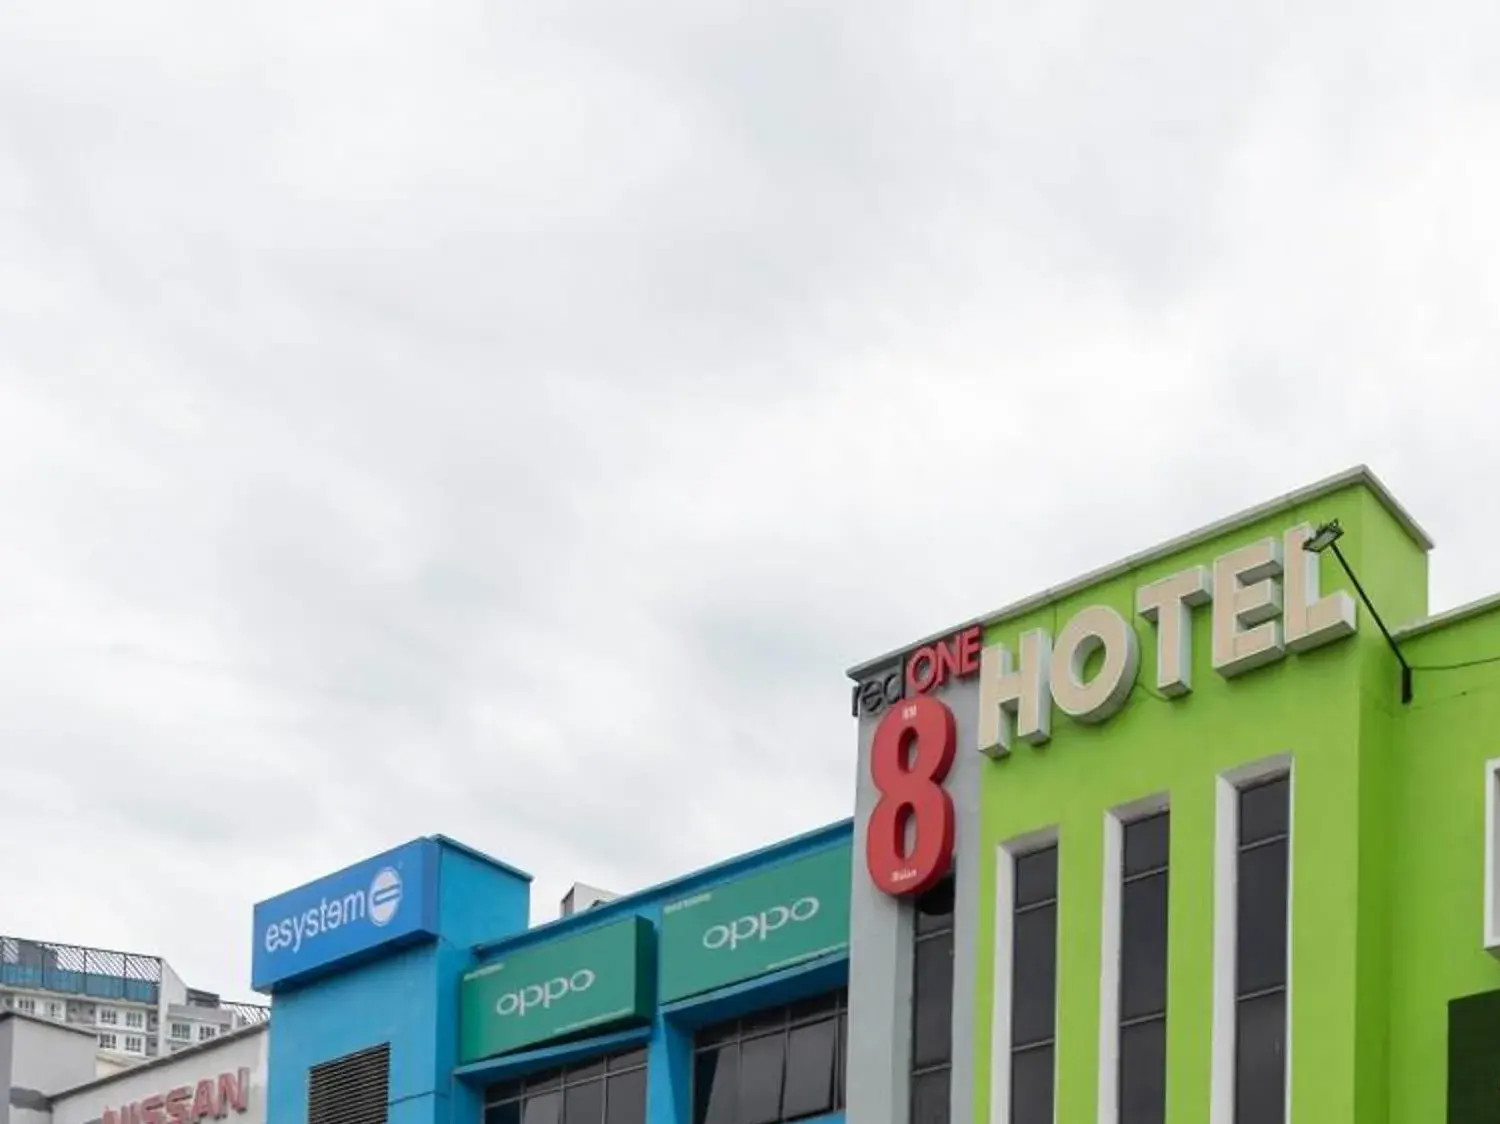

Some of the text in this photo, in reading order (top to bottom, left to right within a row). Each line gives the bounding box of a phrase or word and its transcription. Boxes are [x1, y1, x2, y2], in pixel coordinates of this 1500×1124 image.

[977, 522, 1357, 760] HOTEL
[866, 695, 957, 894] 8
[703, 896, 820, 951] oppo
[495, 968, 596, 1017] oppo
